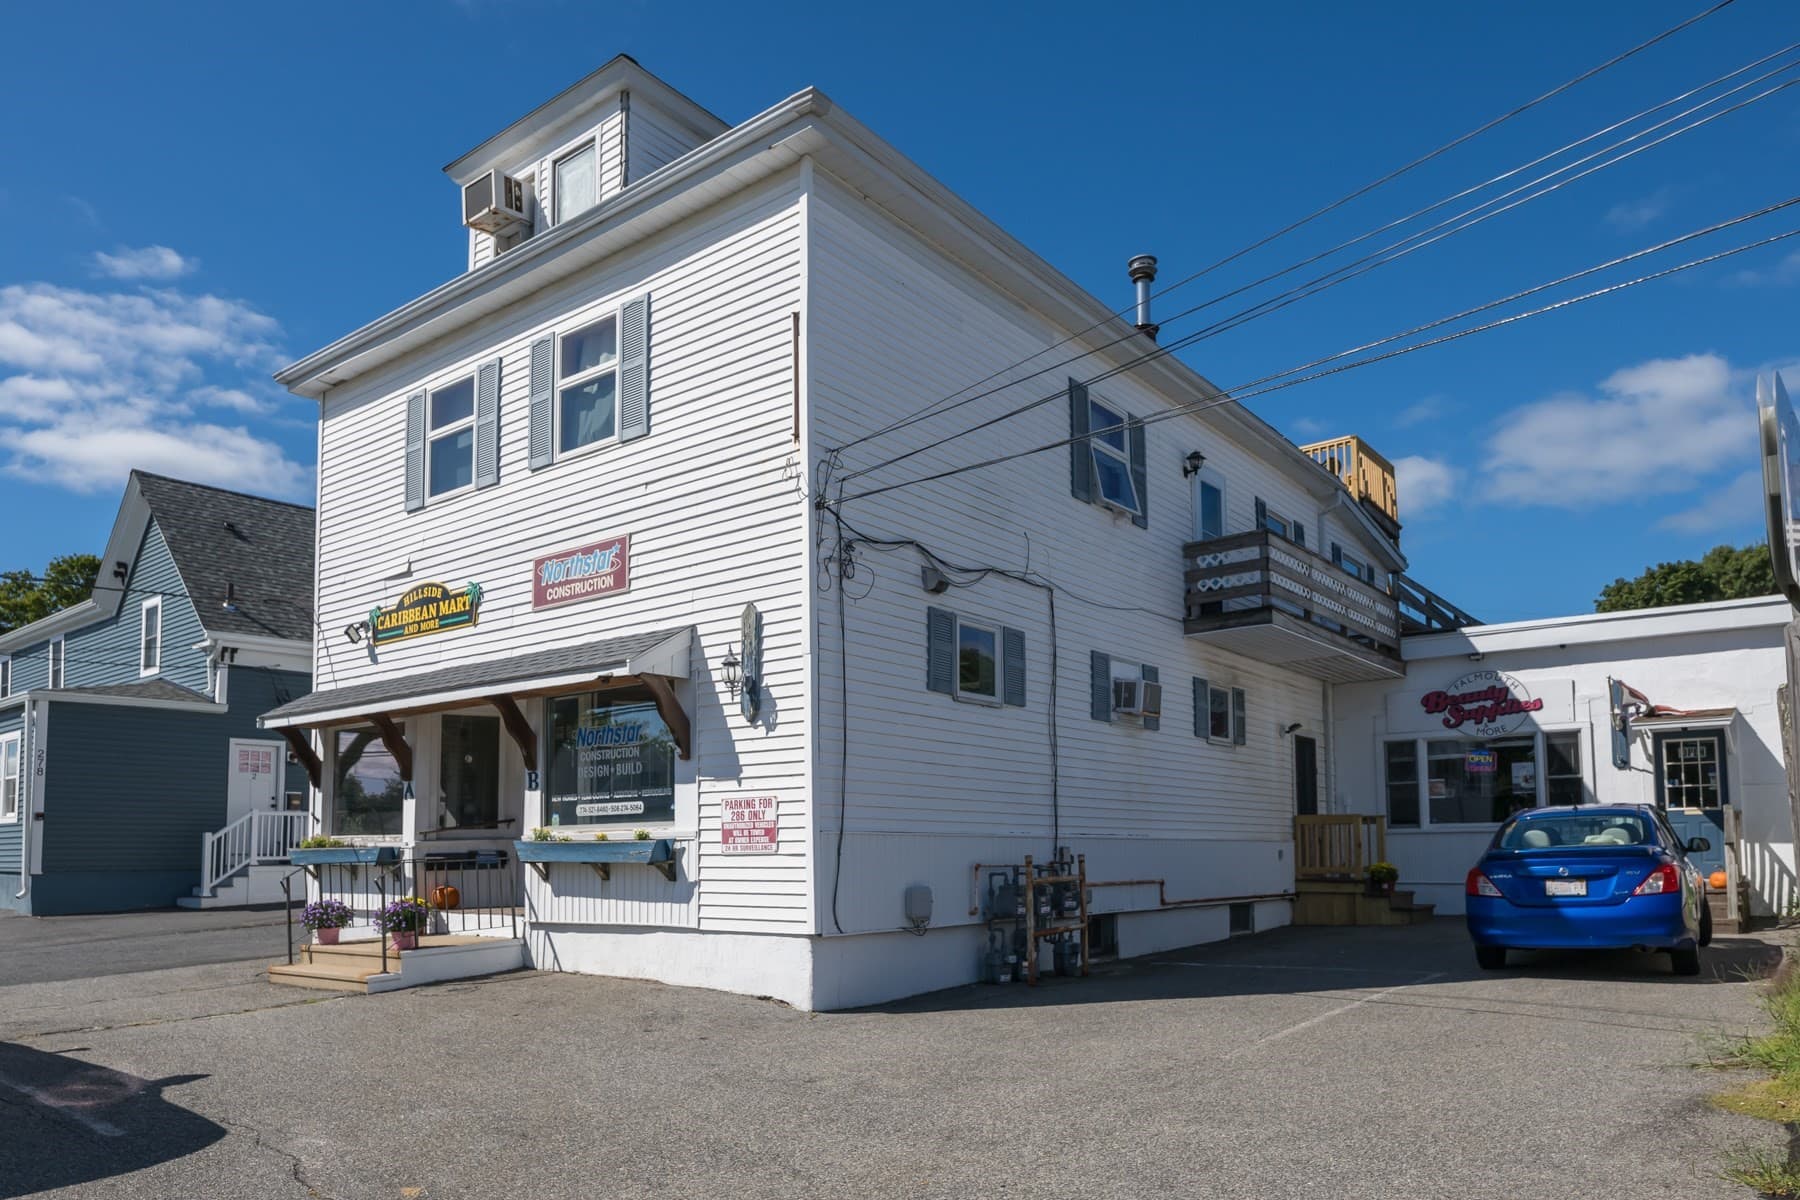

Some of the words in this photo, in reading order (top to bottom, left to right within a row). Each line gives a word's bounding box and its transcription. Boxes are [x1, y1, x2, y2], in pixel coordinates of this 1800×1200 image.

[541, 548, 615, 586] Northstar
[403, 586, 443, 607] HILLSIDE
[546, 574, 614, 600] CONSTRUCTION
[377, 602, 438, 630] CARIBBEAN
[439, 594, 472, 616] MART
[403, 623, 418, 635] AND
[420, 618, 440, 632] MORE
[1454, 672, 1519, 690] FALMOUTH
[1420, 685, 1509, 714] Beauty
[1442, 698, 1543, 729] Supplies
[576, 724, 642, 749] Northstar
[1476, 725, 1507, 736] MORE
[580, 746, 640, 761] CONSTRUCTION
[578, 764, 609, 778] DESIGN
[616, 762, 643, 776] BUILD
[404, 781, 414, 799] A
[527, 771, 539, 791] B
[725, 799, 756, 810] PARKING
[759, 798, 773, 808] FOR
[731, 810, 745, 821] 286
[748, 810, 766, 820] ONLY
